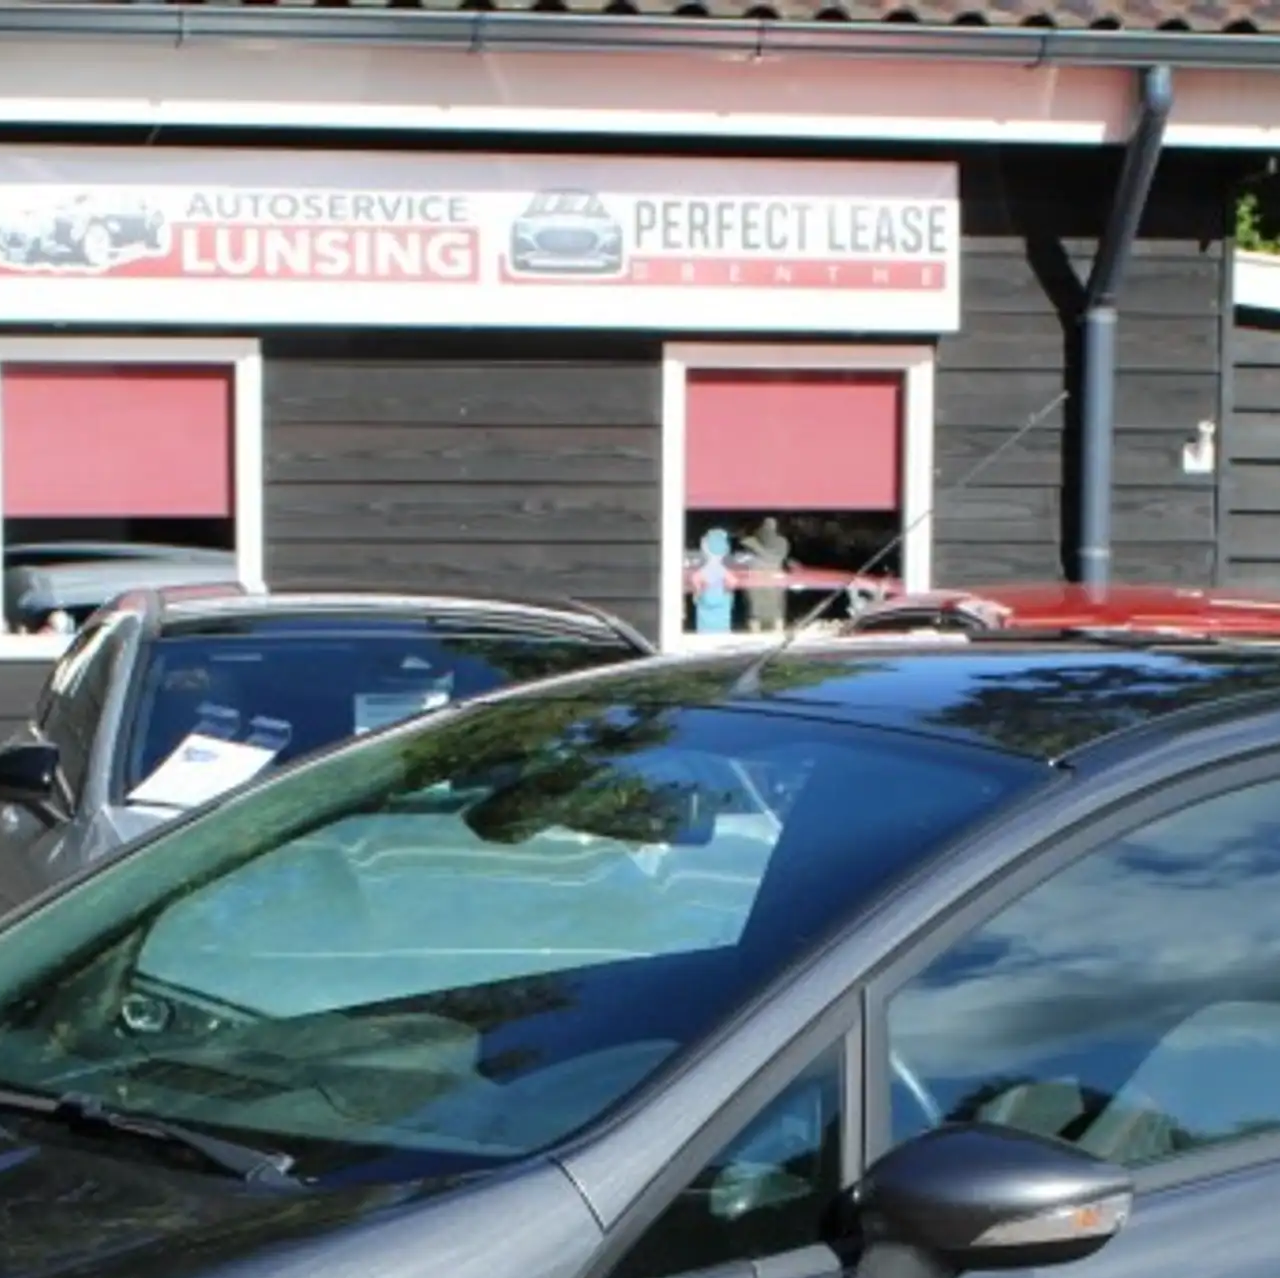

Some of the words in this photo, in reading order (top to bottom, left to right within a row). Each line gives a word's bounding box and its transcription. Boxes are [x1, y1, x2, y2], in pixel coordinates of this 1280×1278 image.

[186, 191, 470, 223] AUTOSERVICE
[633, 199, 812, 251] PERFECT
[827, 204, 948, 254] LEASE
[180, 227, 474, 278] LUNSING
